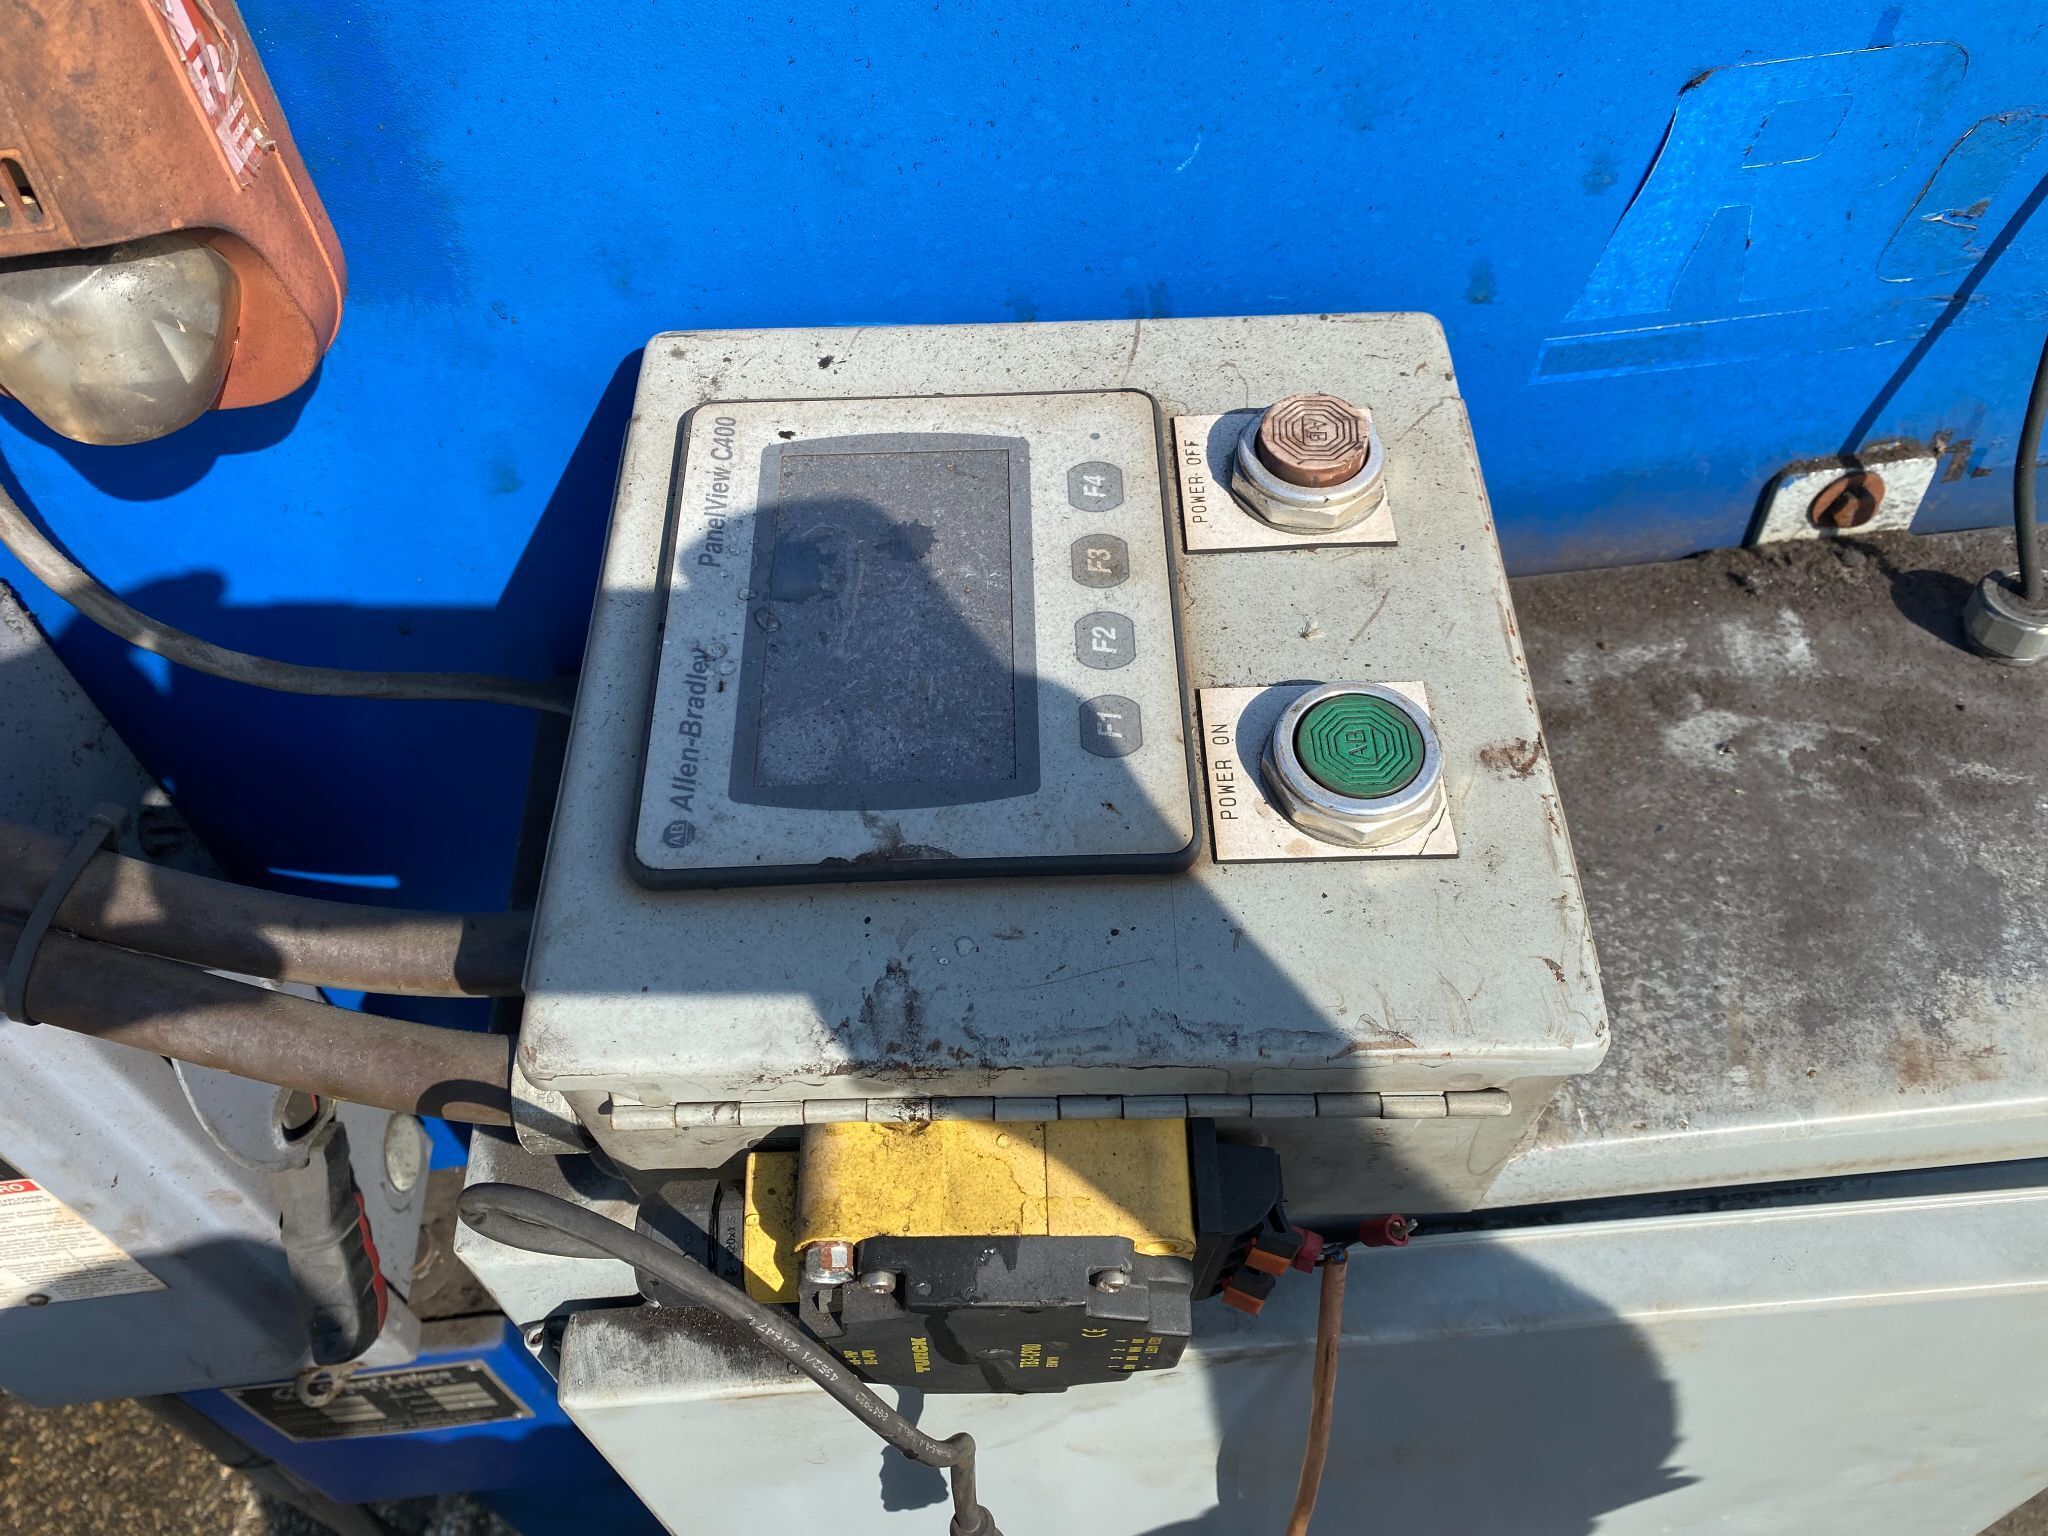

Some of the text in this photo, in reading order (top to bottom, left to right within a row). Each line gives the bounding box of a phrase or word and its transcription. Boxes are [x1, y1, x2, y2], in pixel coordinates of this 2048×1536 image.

[697, 416, 737, 568] PanelView C400
[1082, 475, 1107, 498] F4
[1184, 440, 1208, 523] POWER OFF
[1086, 548, 1113, 574] F3
[1091, 626, 1118, 654] F2
[669, 647, 712, 813] Allen-Bradley
[1096, 711, 1123, 738] F1
[1211, 723, 1239, 820] POWER ON
[910, 1337, 931, 1373] TURCK
